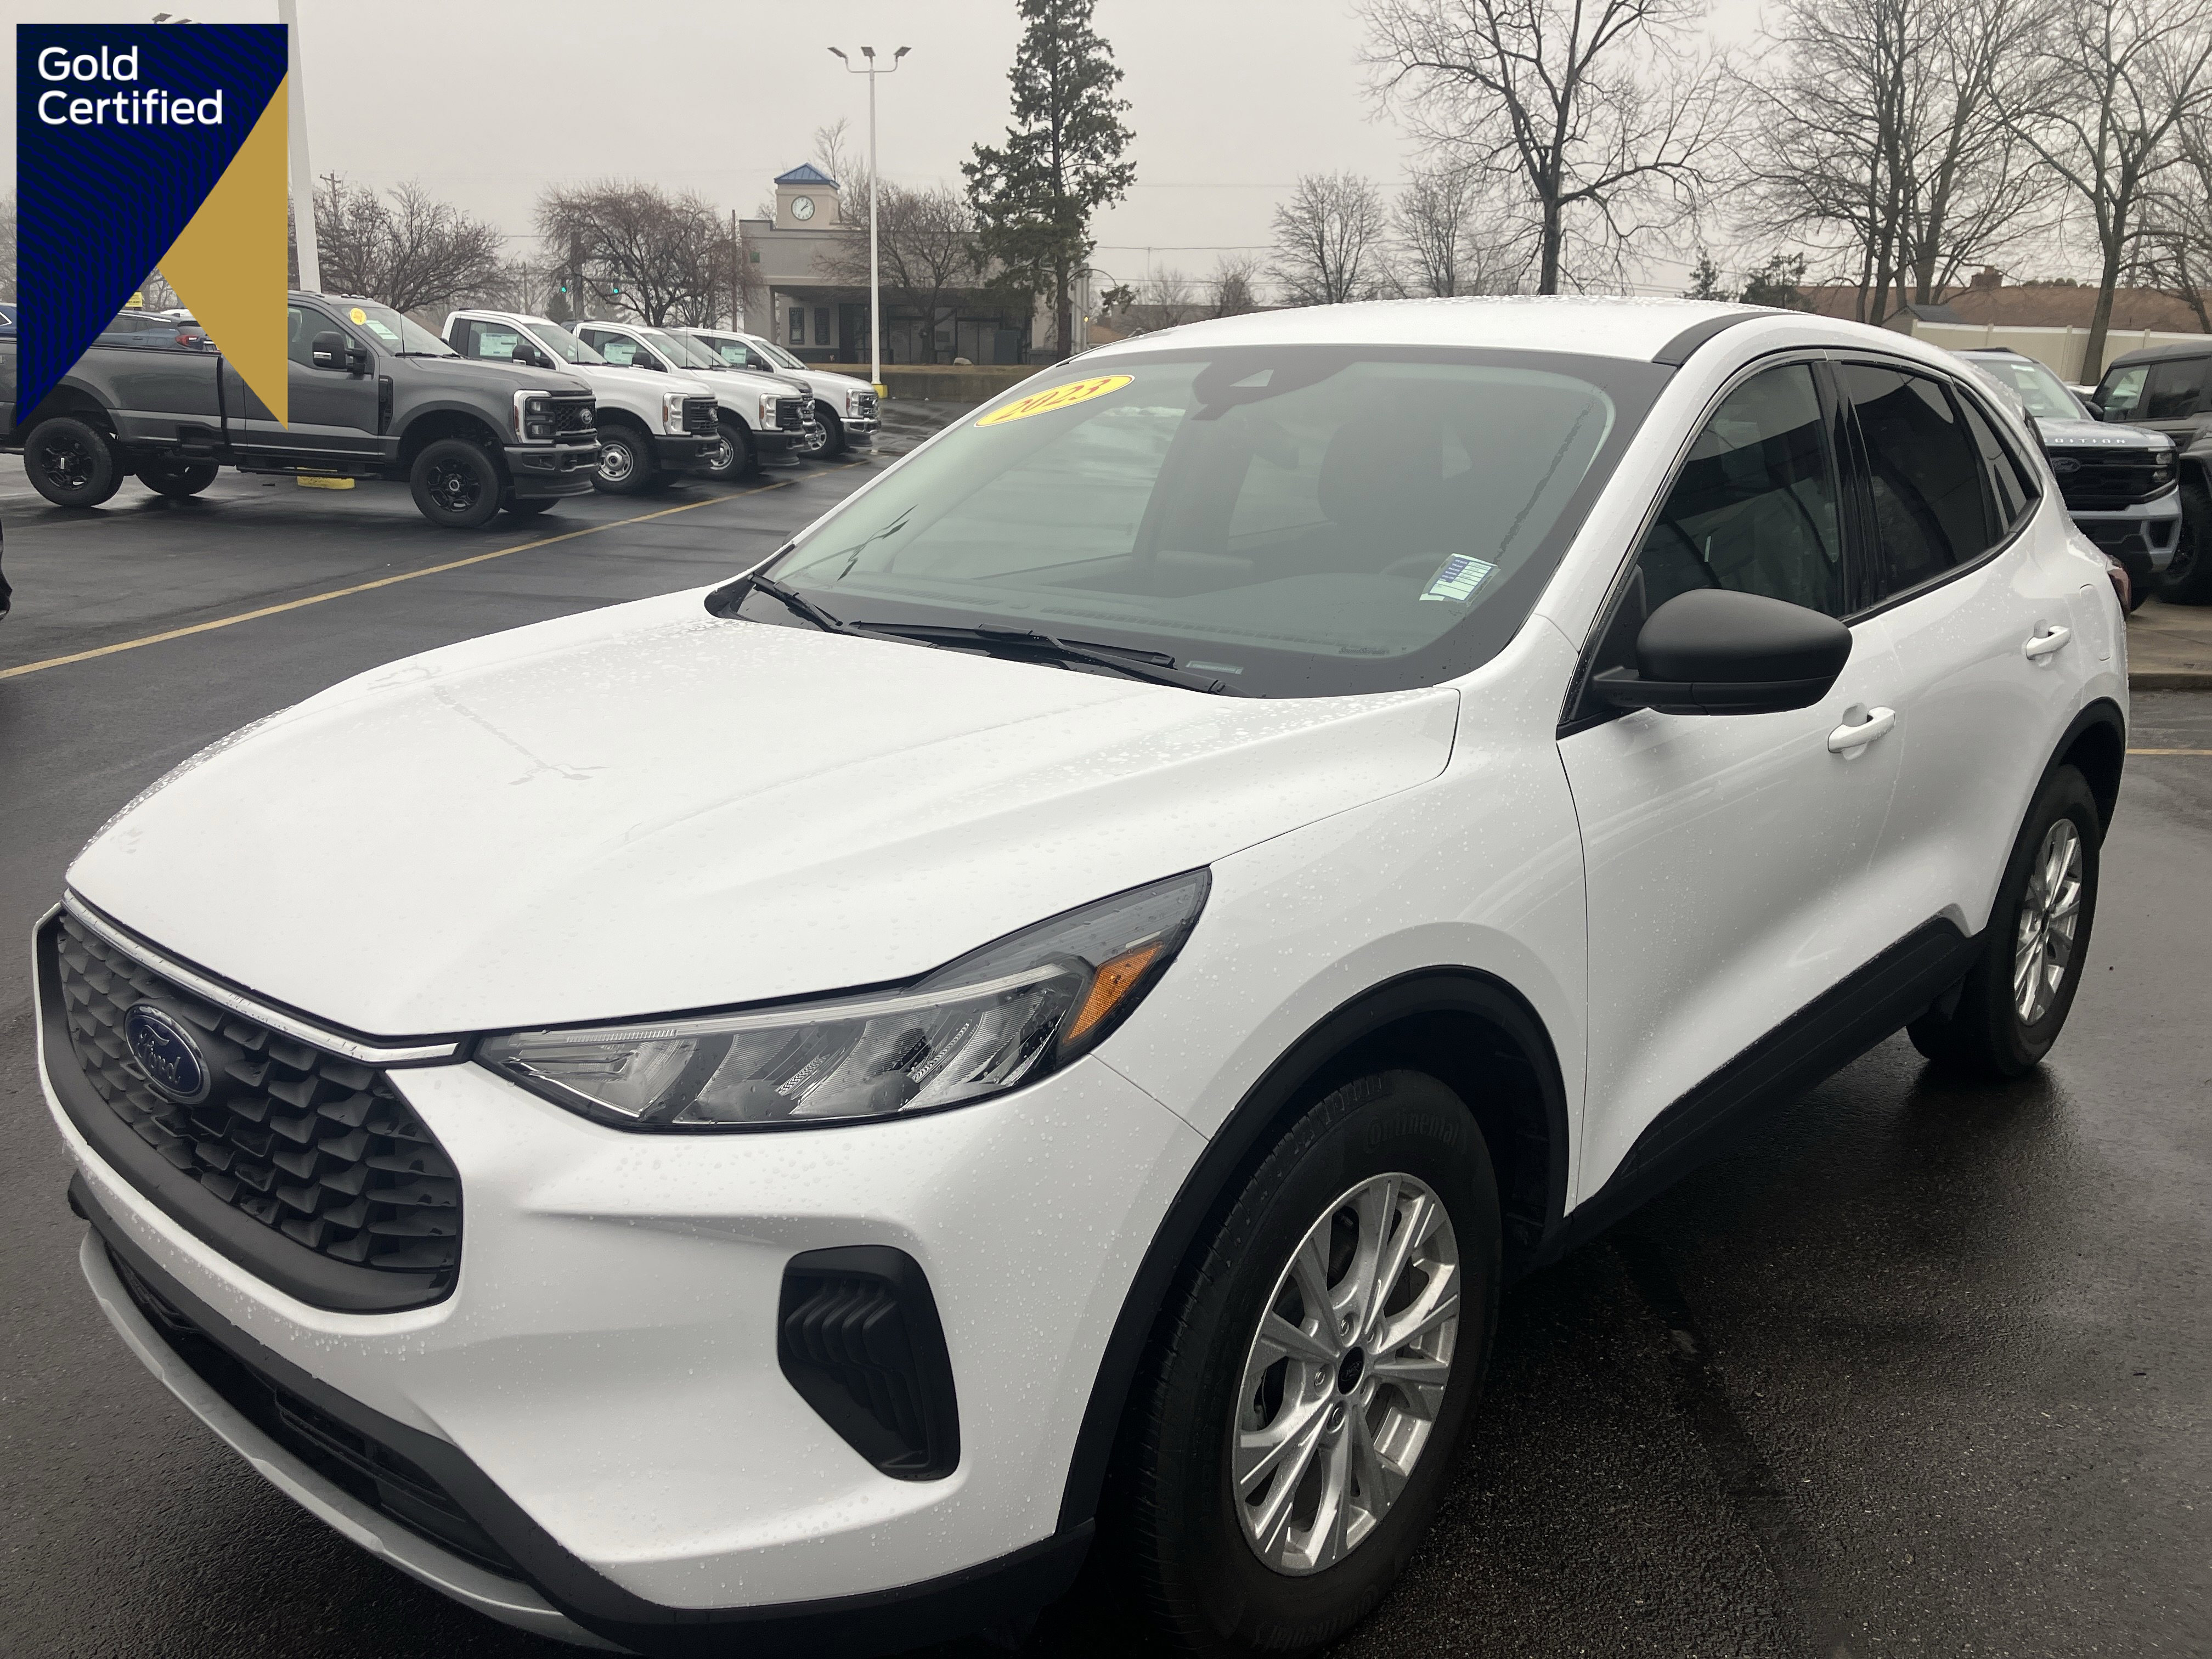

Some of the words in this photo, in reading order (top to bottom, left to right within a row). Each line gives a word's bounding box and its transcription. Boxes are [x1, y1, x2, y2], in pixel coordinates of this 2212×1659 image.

[991, 379, 1111, 422] 2023
[137, 1024, 181, 1085] Ford
[1363, 1111, 1460, 1154] Continental
